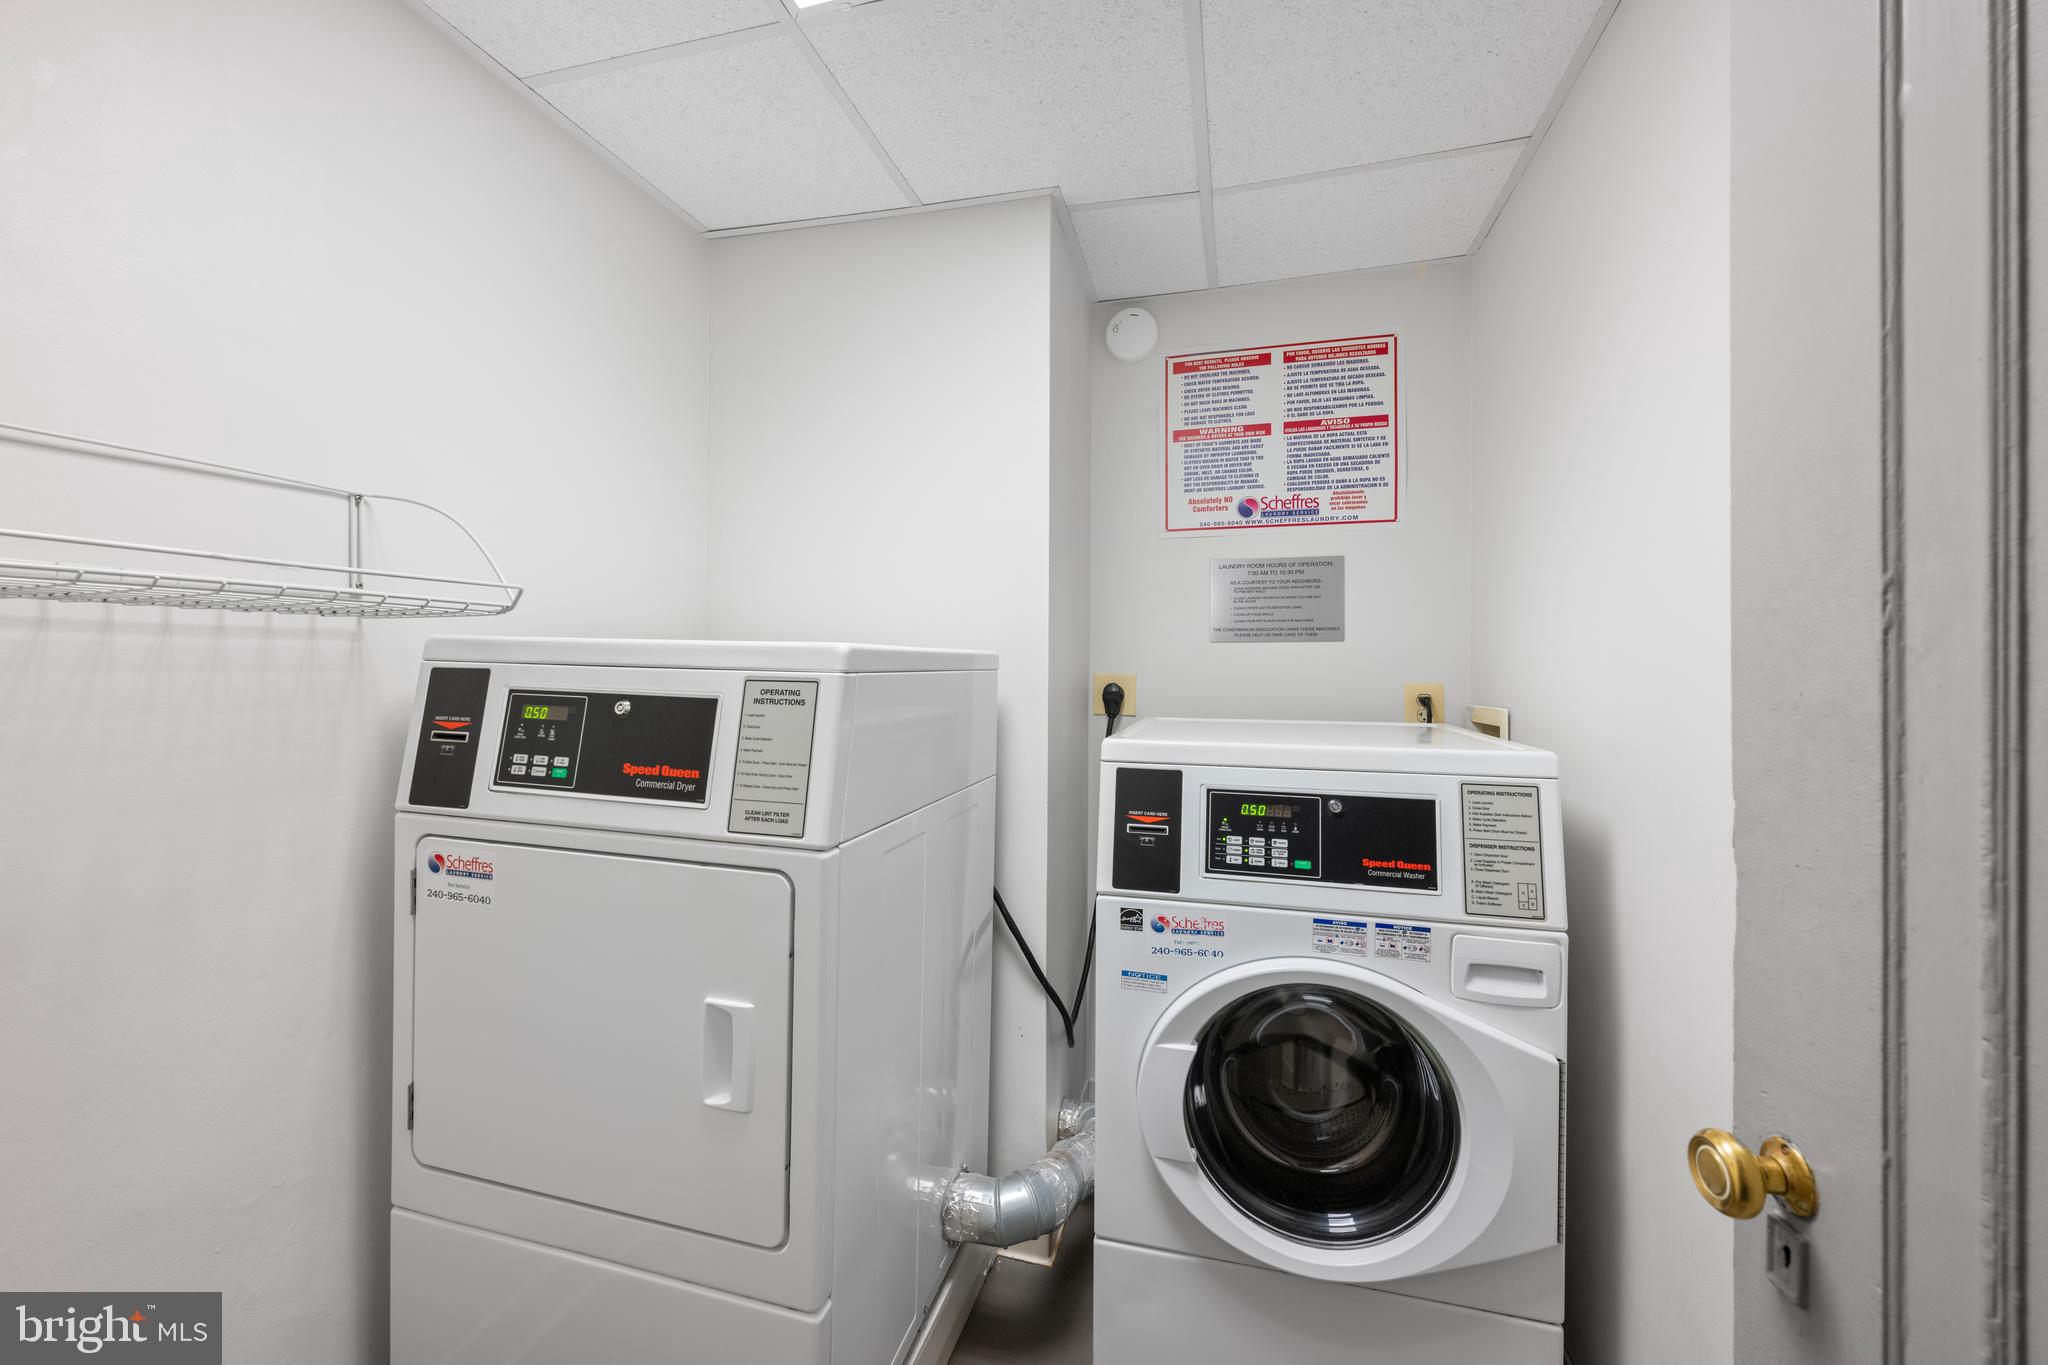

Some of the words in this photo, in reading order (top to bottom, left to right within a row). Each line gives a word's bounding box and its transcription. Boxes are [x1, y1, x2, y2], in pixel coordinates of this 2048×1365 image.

[1199, 426, 1244, 435] WARNING
[1260, 494, 1320, 511] Scheffres
[622, 762, 660, 777] Speed
[662, 765, 700, 779] Queen
[635, 778, 675, 791] Commercial
[676, 780, 696, 792] Dryer
[446, 854, 494, 873] Scheffres
[1362, 858, 1395, 870] Speed
[1397, 859, 1432, 871] Queen
[1367, 869, 1402, 879] Commercial
[1403, 871, 1425, 880] Washer
[427, 888, 491, 905] 240-965-6040
[1128, 971, 1161, 980] NOTICE
